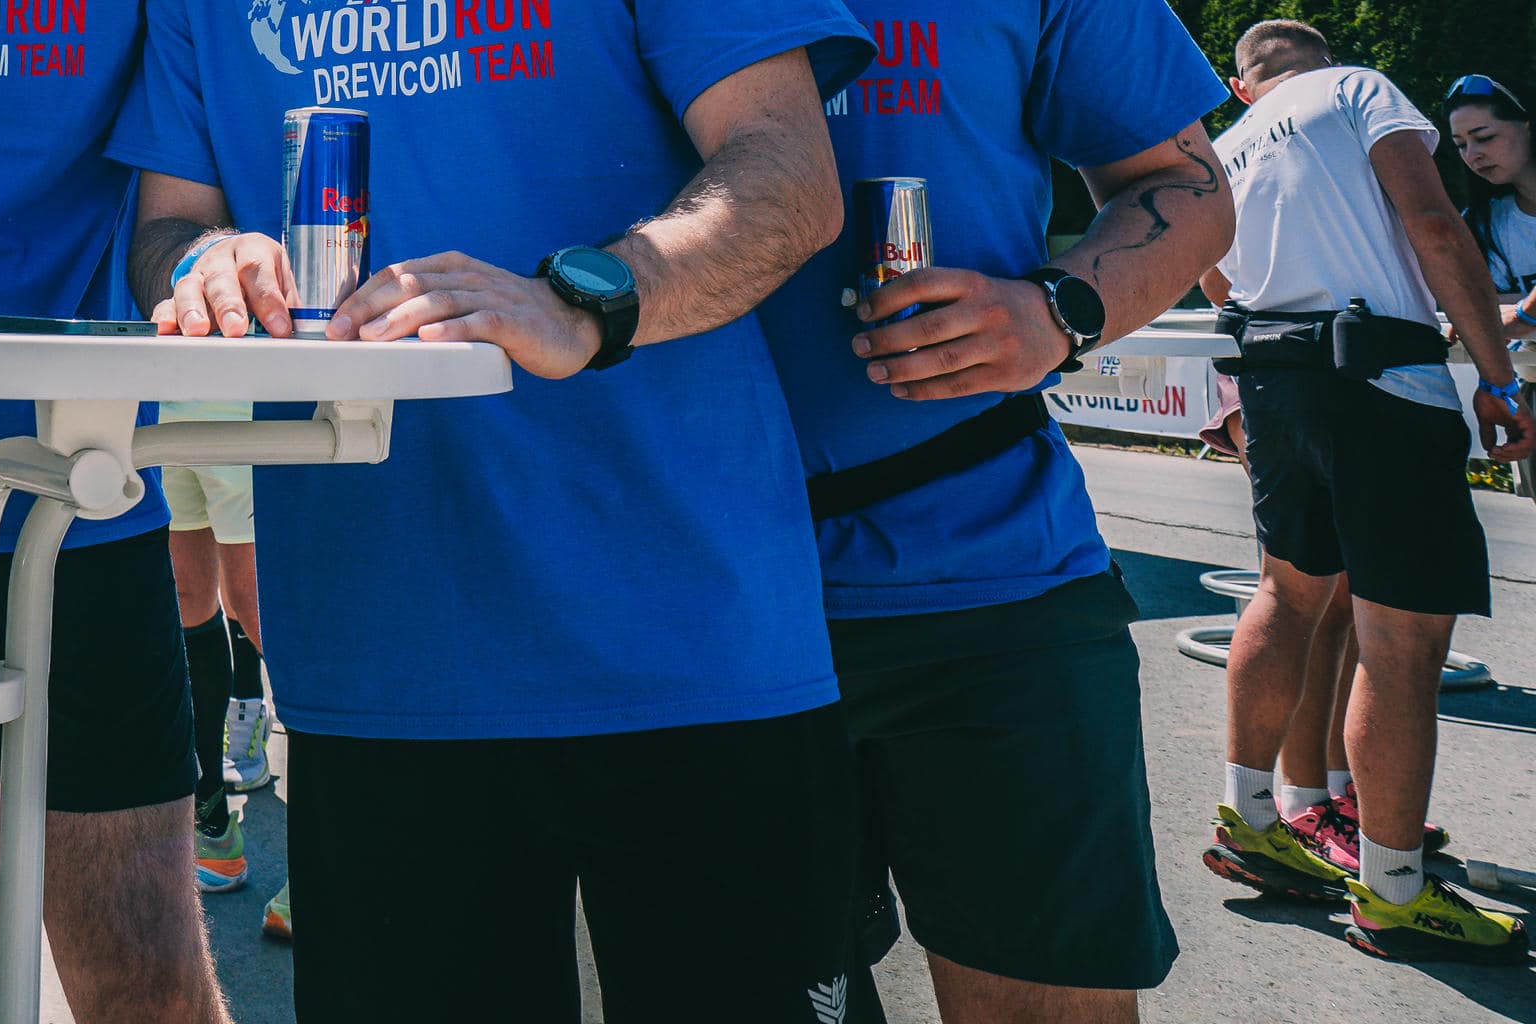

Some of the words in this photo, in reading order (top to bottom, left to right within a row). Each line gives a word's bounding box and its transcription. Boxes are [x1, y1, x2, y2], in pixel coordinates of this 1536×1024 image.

[16, 43, 85, 77] TEAM
[873, 21, 940, 68] UN
[313, 50, 462, 105] DREVICOM
[467, 40, 555, 83] TEAM
[857, 79, 941, 115] TEAM
[326, 239, 363, 249] ENERG
[882, 242, 924, 262] Bull
